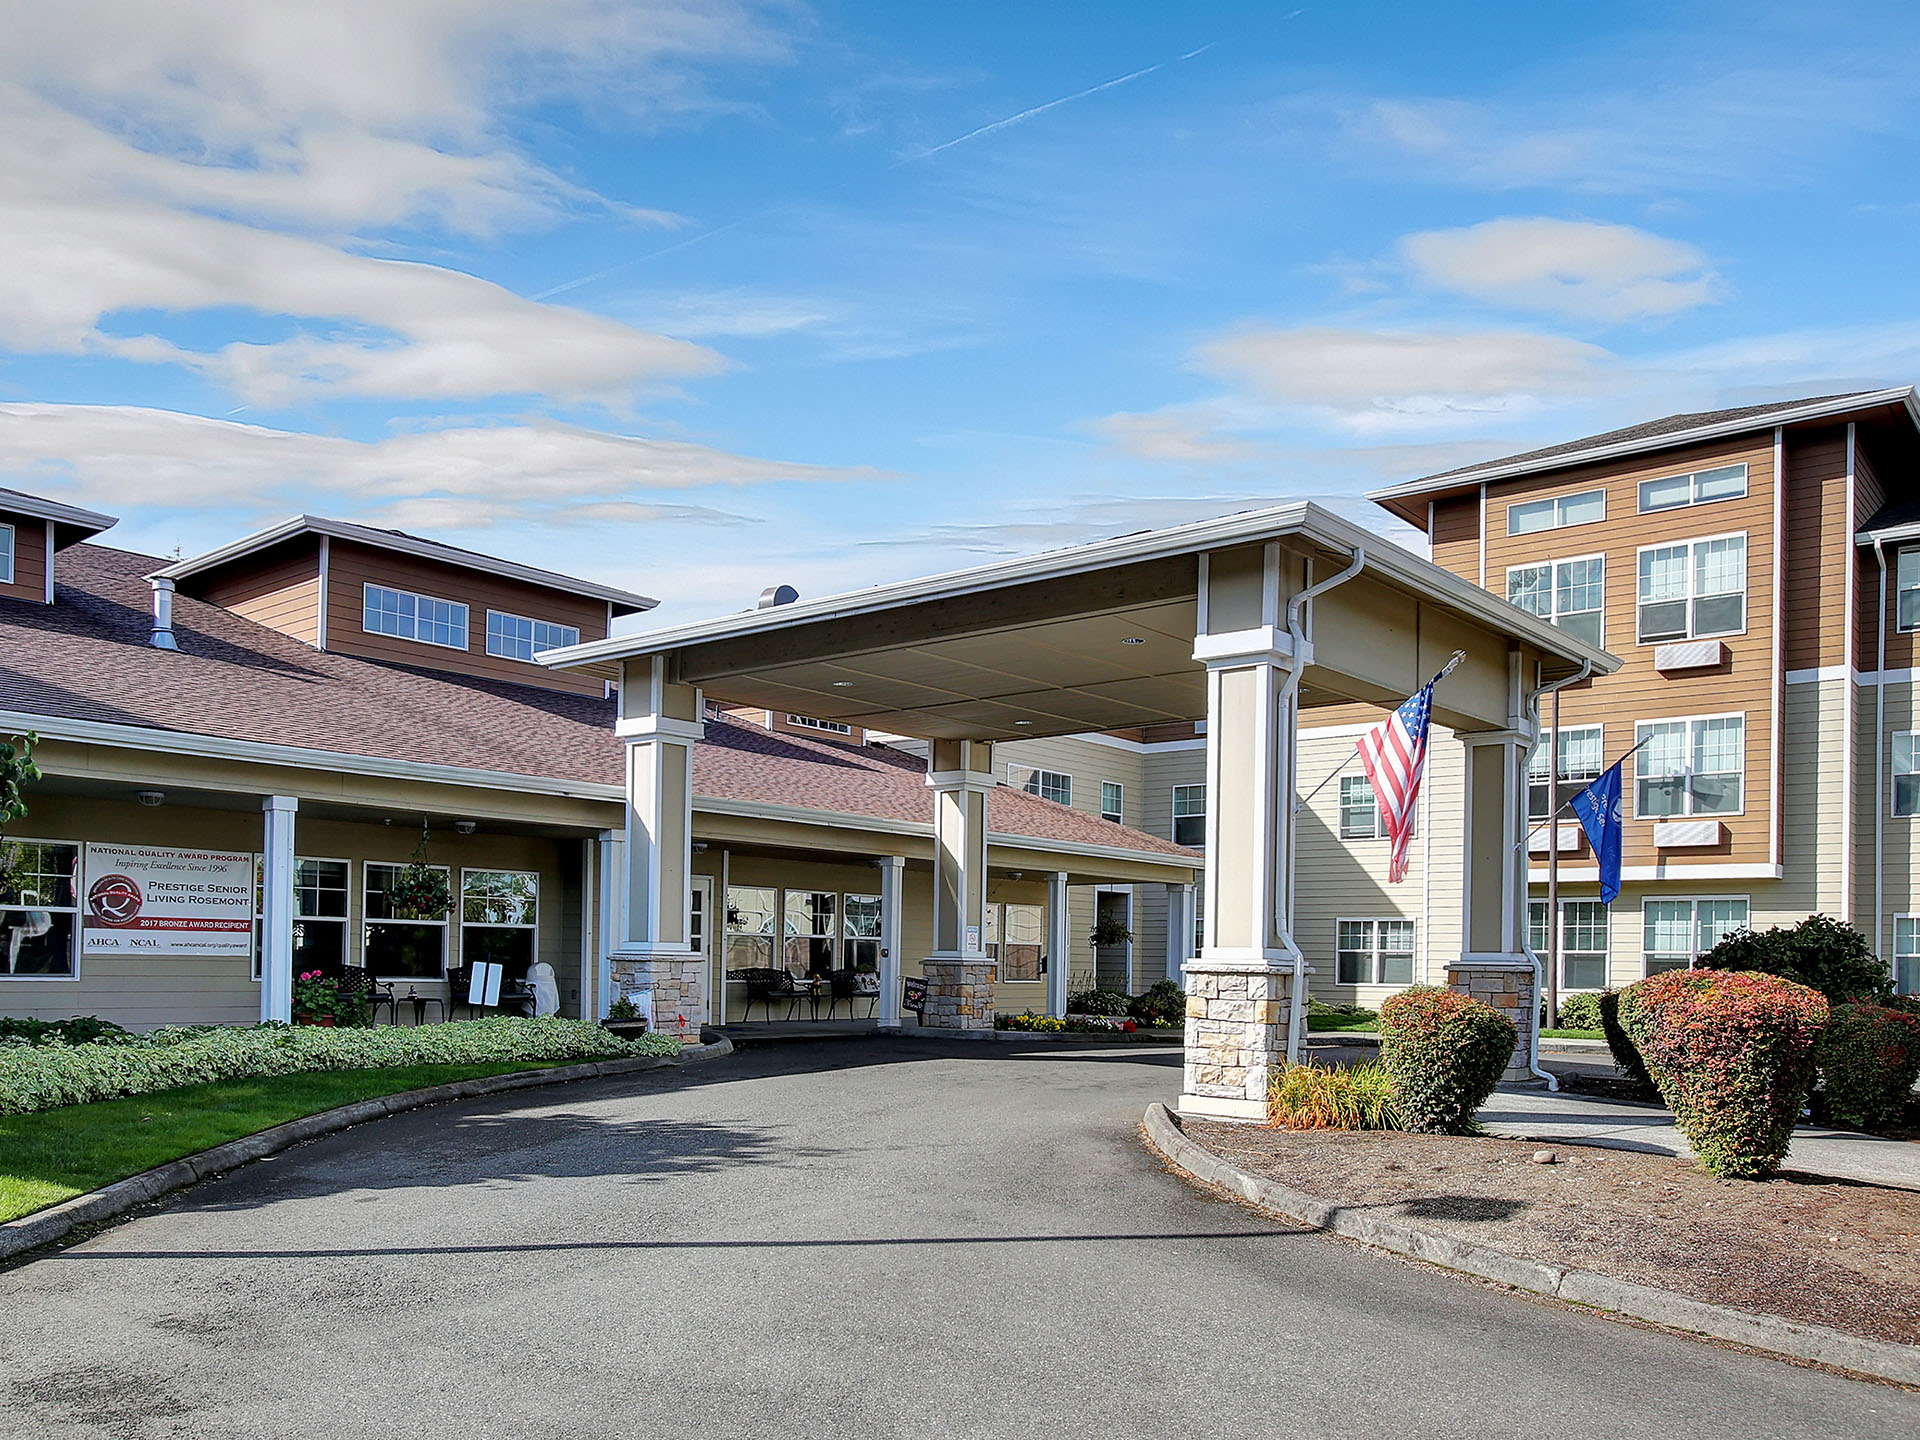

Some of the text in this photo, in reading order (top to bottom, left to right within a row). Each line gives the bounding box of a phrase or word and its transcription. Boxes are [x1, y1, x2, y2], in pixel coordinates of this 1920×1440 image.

[90, 847, 136, 856] NATIONAL
[138, 850, 176, 858] QUALITY
[210, 854, 250, 862] PROGRAM
[115, 859, 228, 873] Inspiring Excellence Since 1996
[148, 881, 204, 892] PRESTIGE
[207, 884, 248, 894] SENIOR
[146, 894, 249, 906] LIVING ROSEMONT
[159, 920, 188, 928] BRONZE
[88, 938, 119, 946] AHCA
